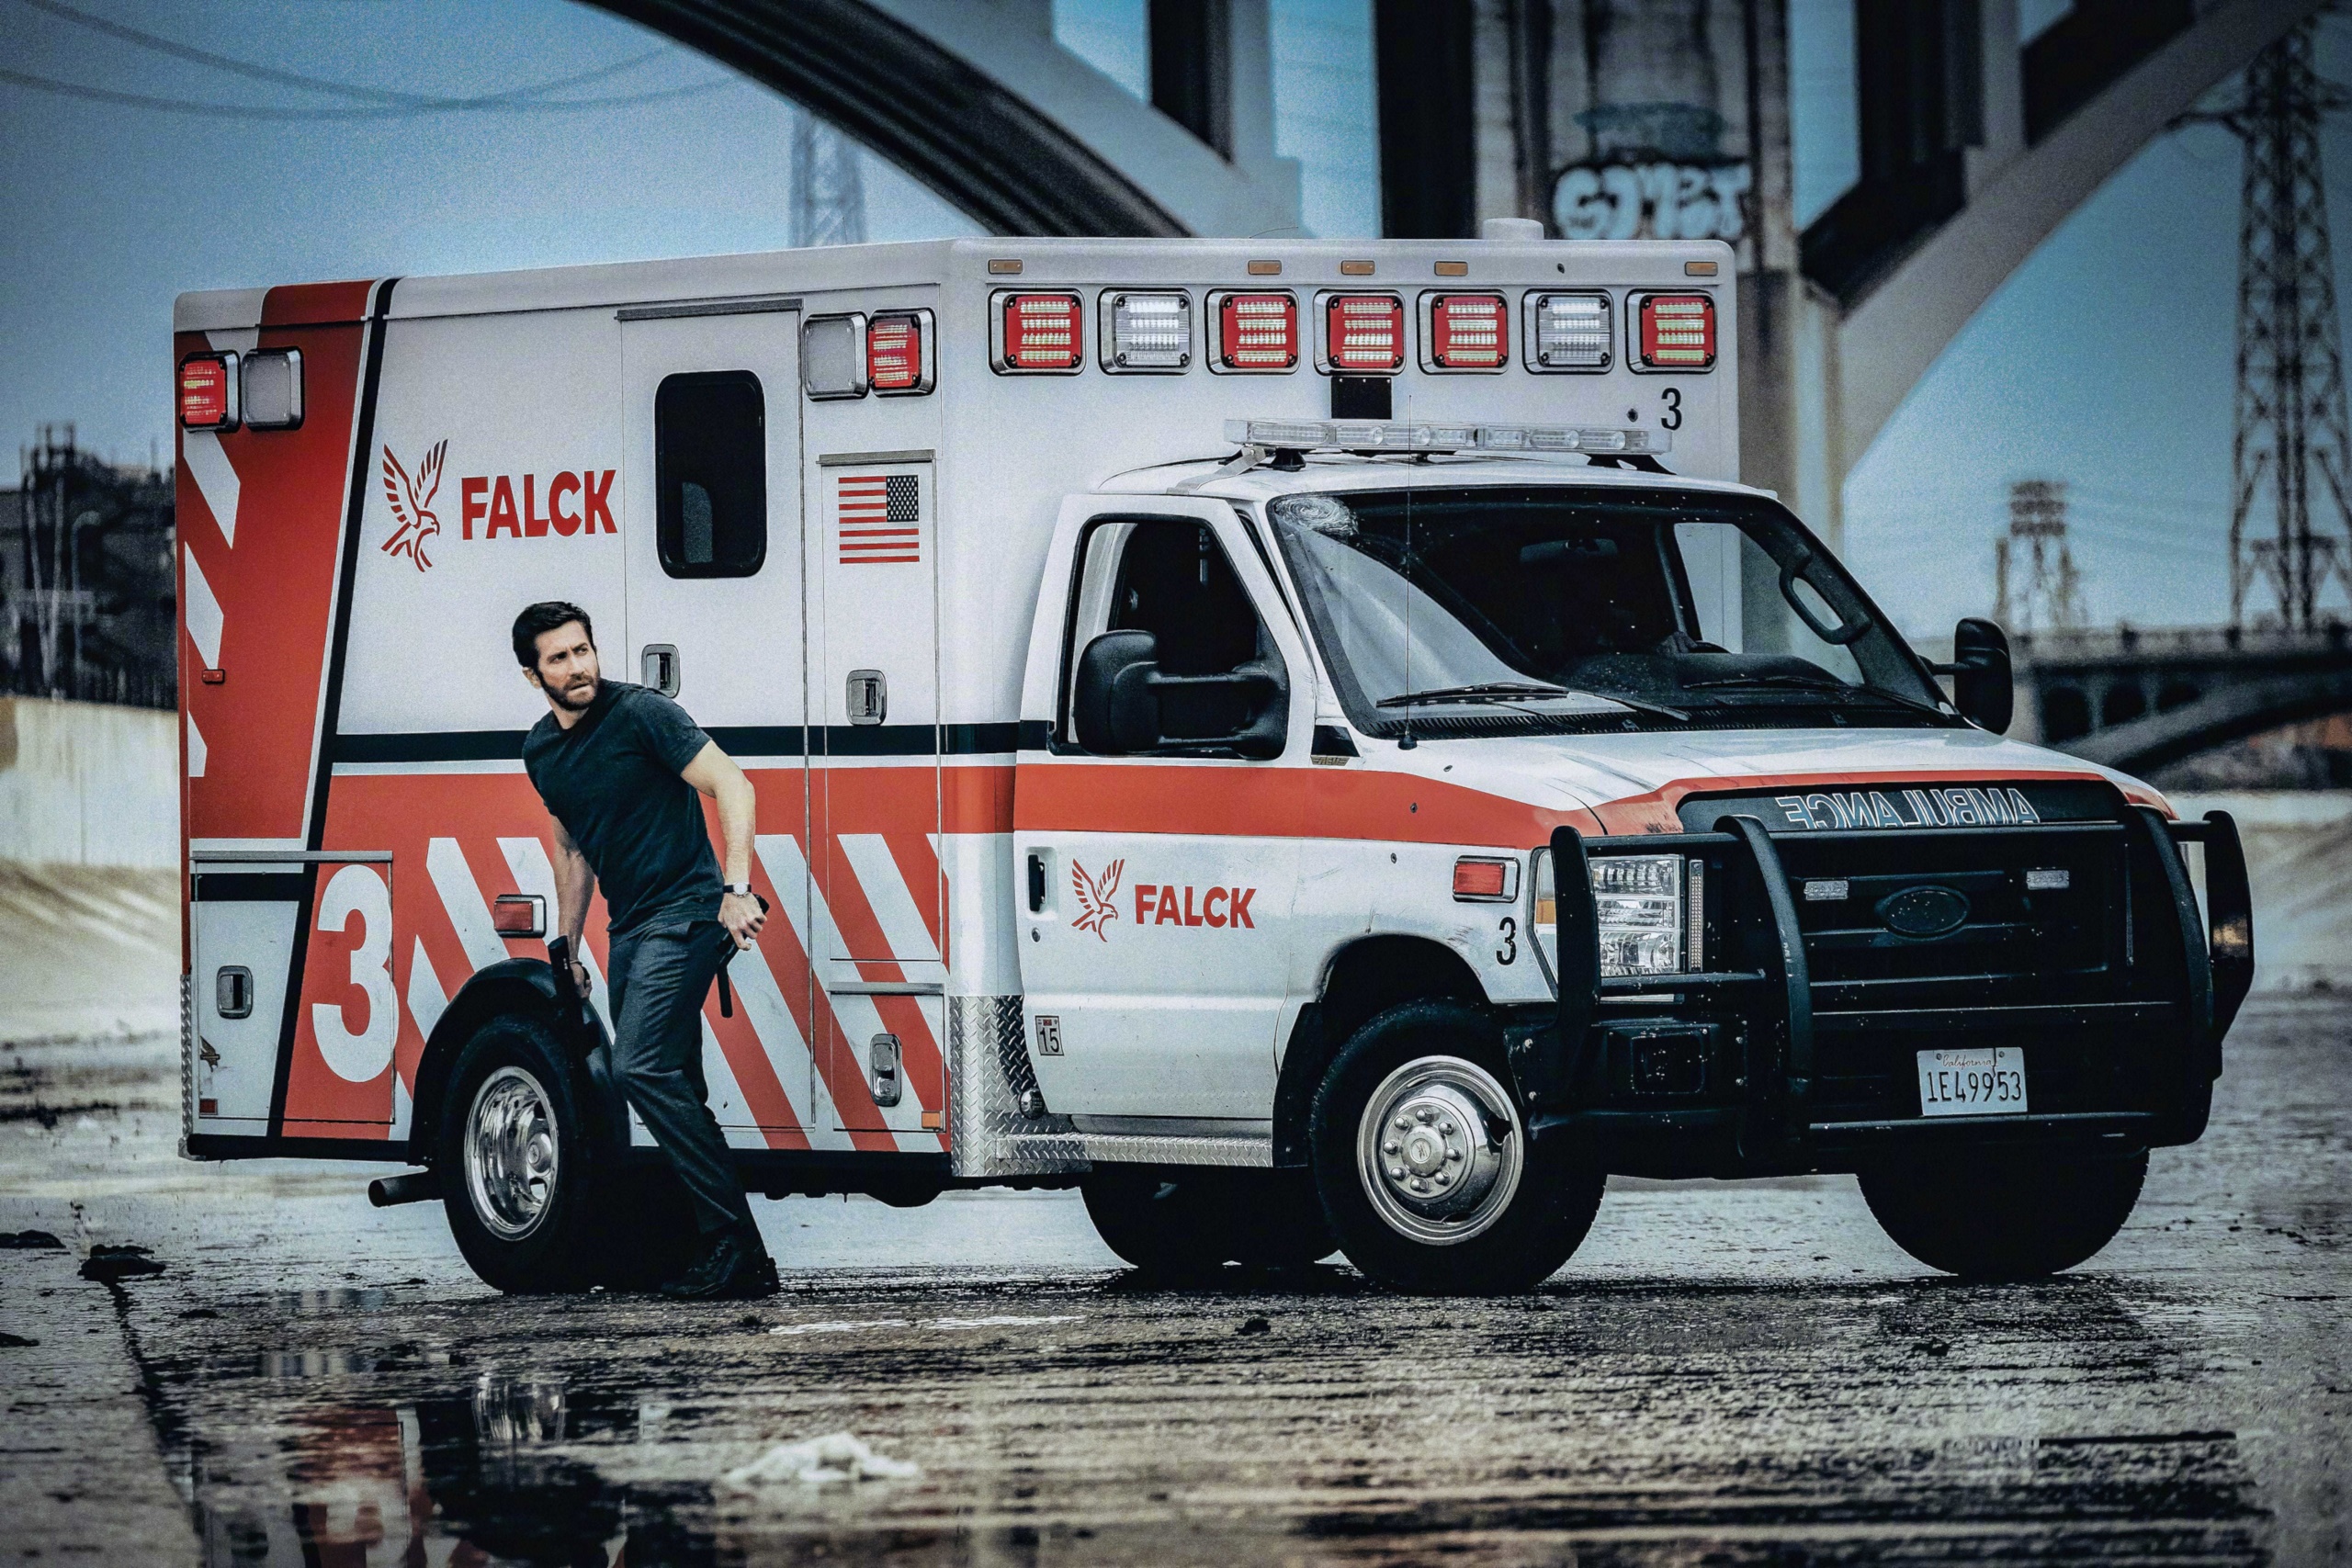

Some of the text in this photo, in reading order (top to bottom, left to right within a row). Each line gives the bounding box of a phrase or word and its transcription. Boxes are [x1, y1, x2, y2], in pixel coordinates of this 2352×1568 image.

[1661, 388, 1682, 431] 3
[461, 469, 618, 540] FALCK
[1135, 884, 1257, 929] FALCK
[1496, 916, 1517, 965] 3
[312, 864, 400, 1082] 3
[1039, 1027, 1059, 1053] 15
[1942, 1055, 1992, 1070] California
[1928, 1071, 2021, 1102] 1E49953
